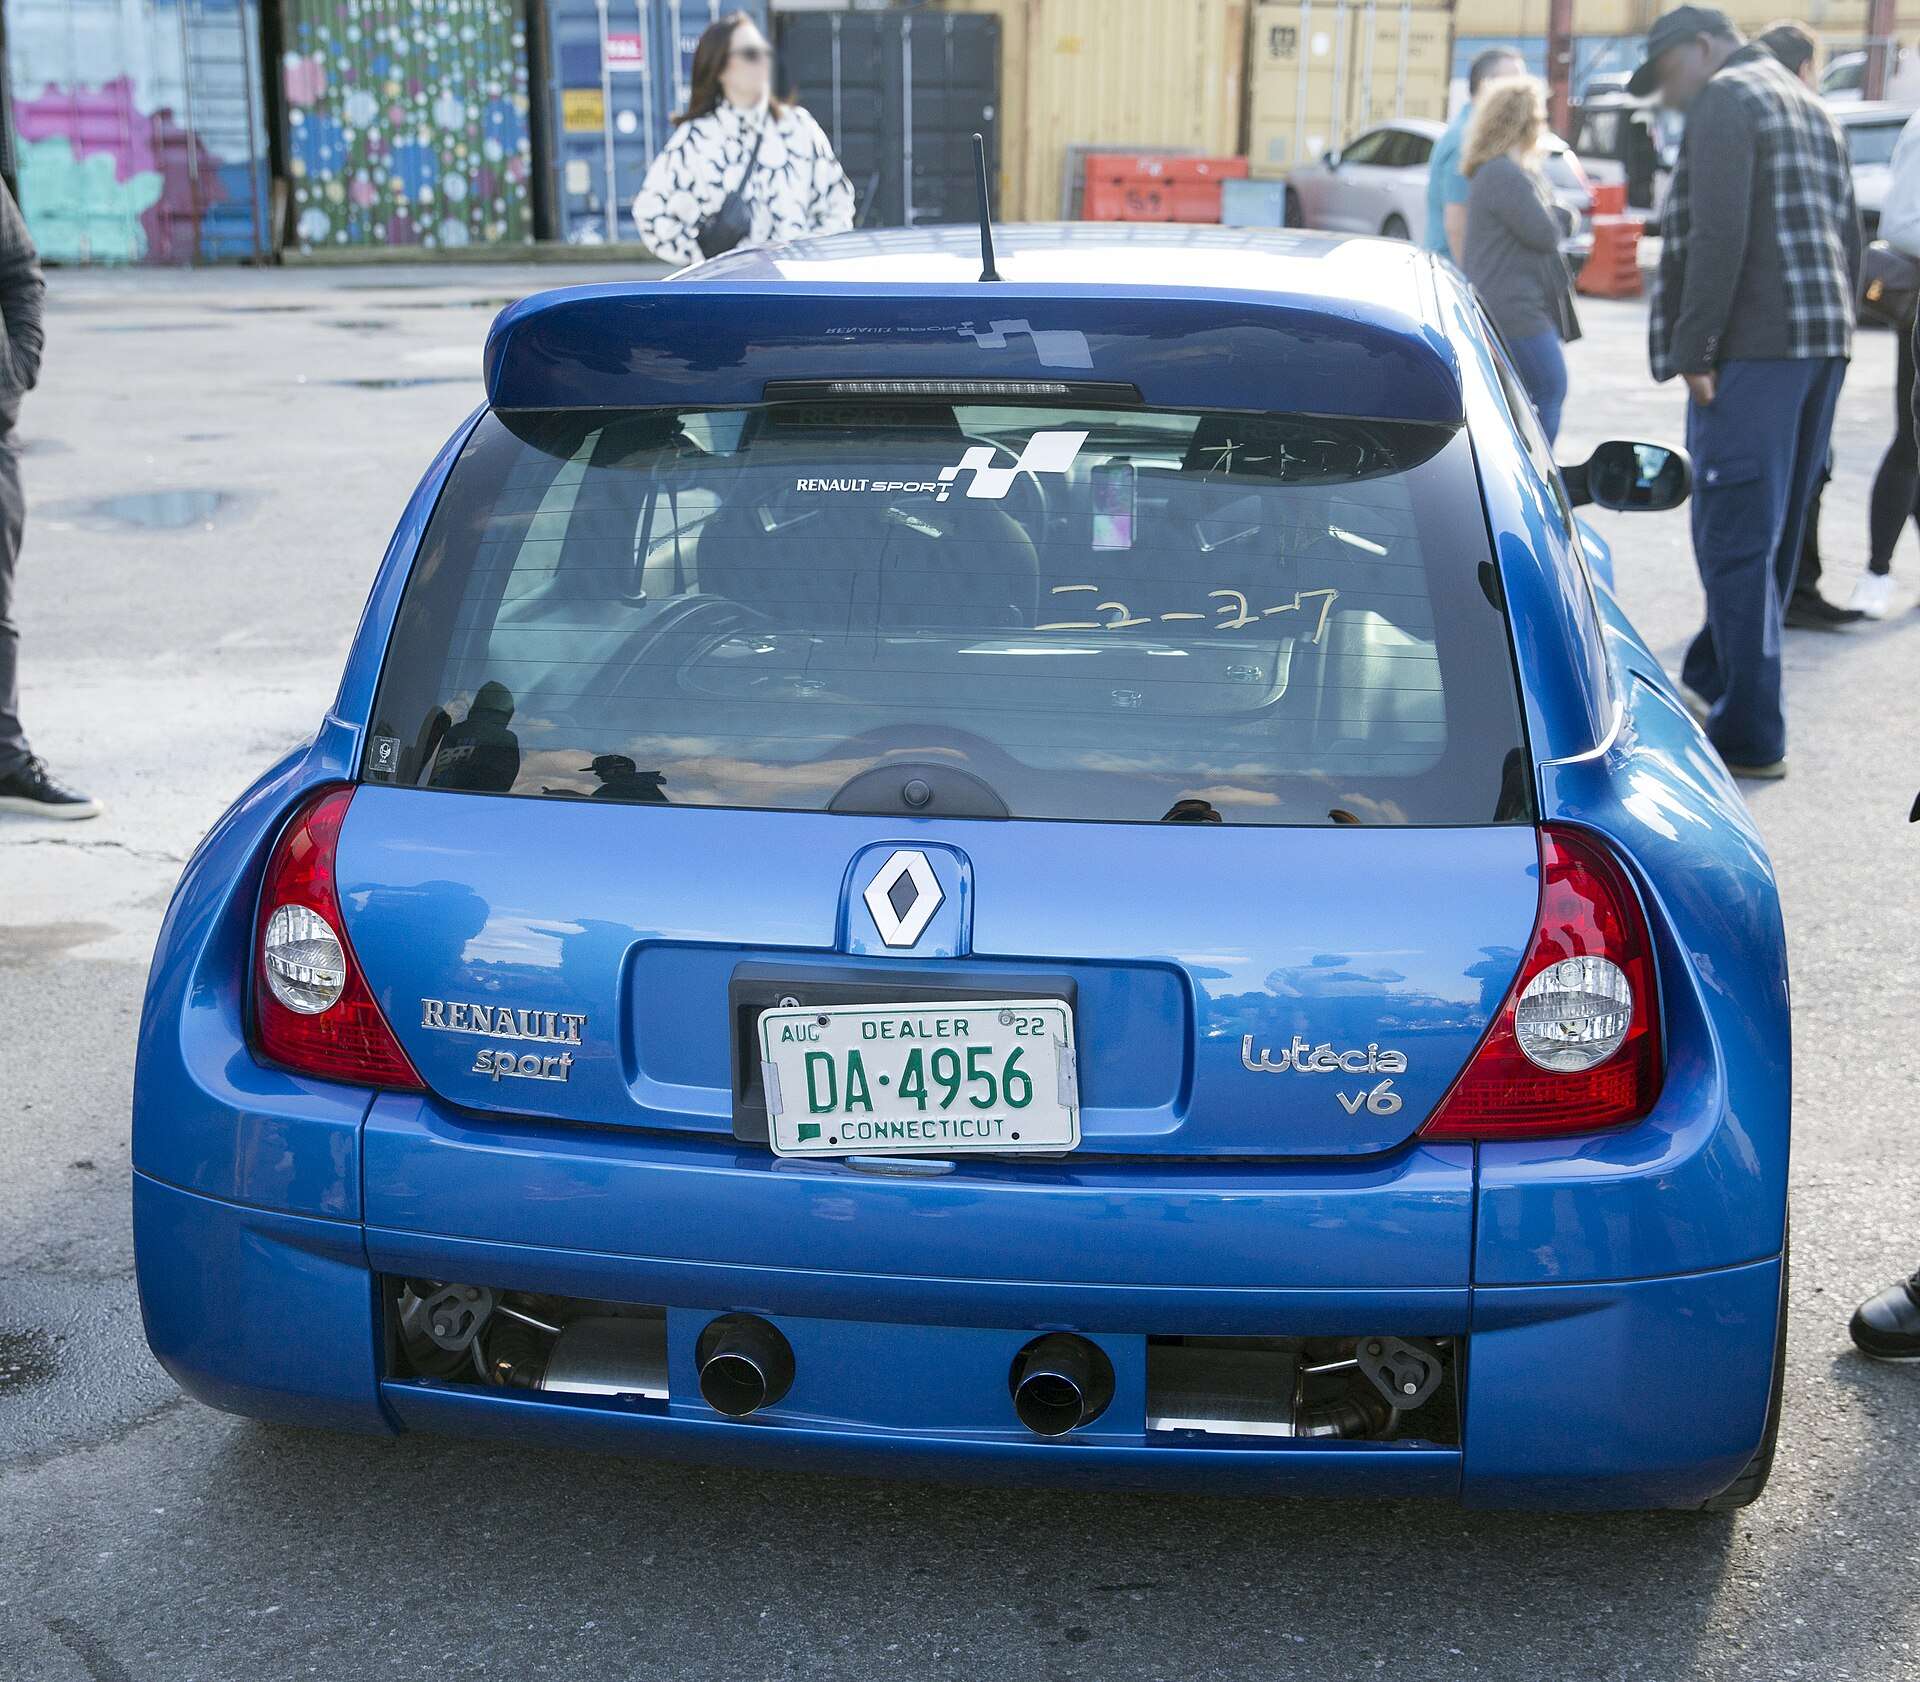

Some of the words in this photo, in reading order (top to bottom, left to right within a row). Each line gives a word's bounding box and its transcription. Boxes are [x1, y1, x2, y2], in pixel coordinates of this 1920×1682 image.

[797, 479, 869, 491] RENAULT
[871, 482, 953, 493] SPORT
[421, 999, 586, 1045] RENAULT
[862, 1019, 969, 1039] DEALER
[1015, 1017, 1044, 1036] 22
[472, 1049, 575, 1082] sport
[841, 1119, 1004, 1140] CONNECTICUT
